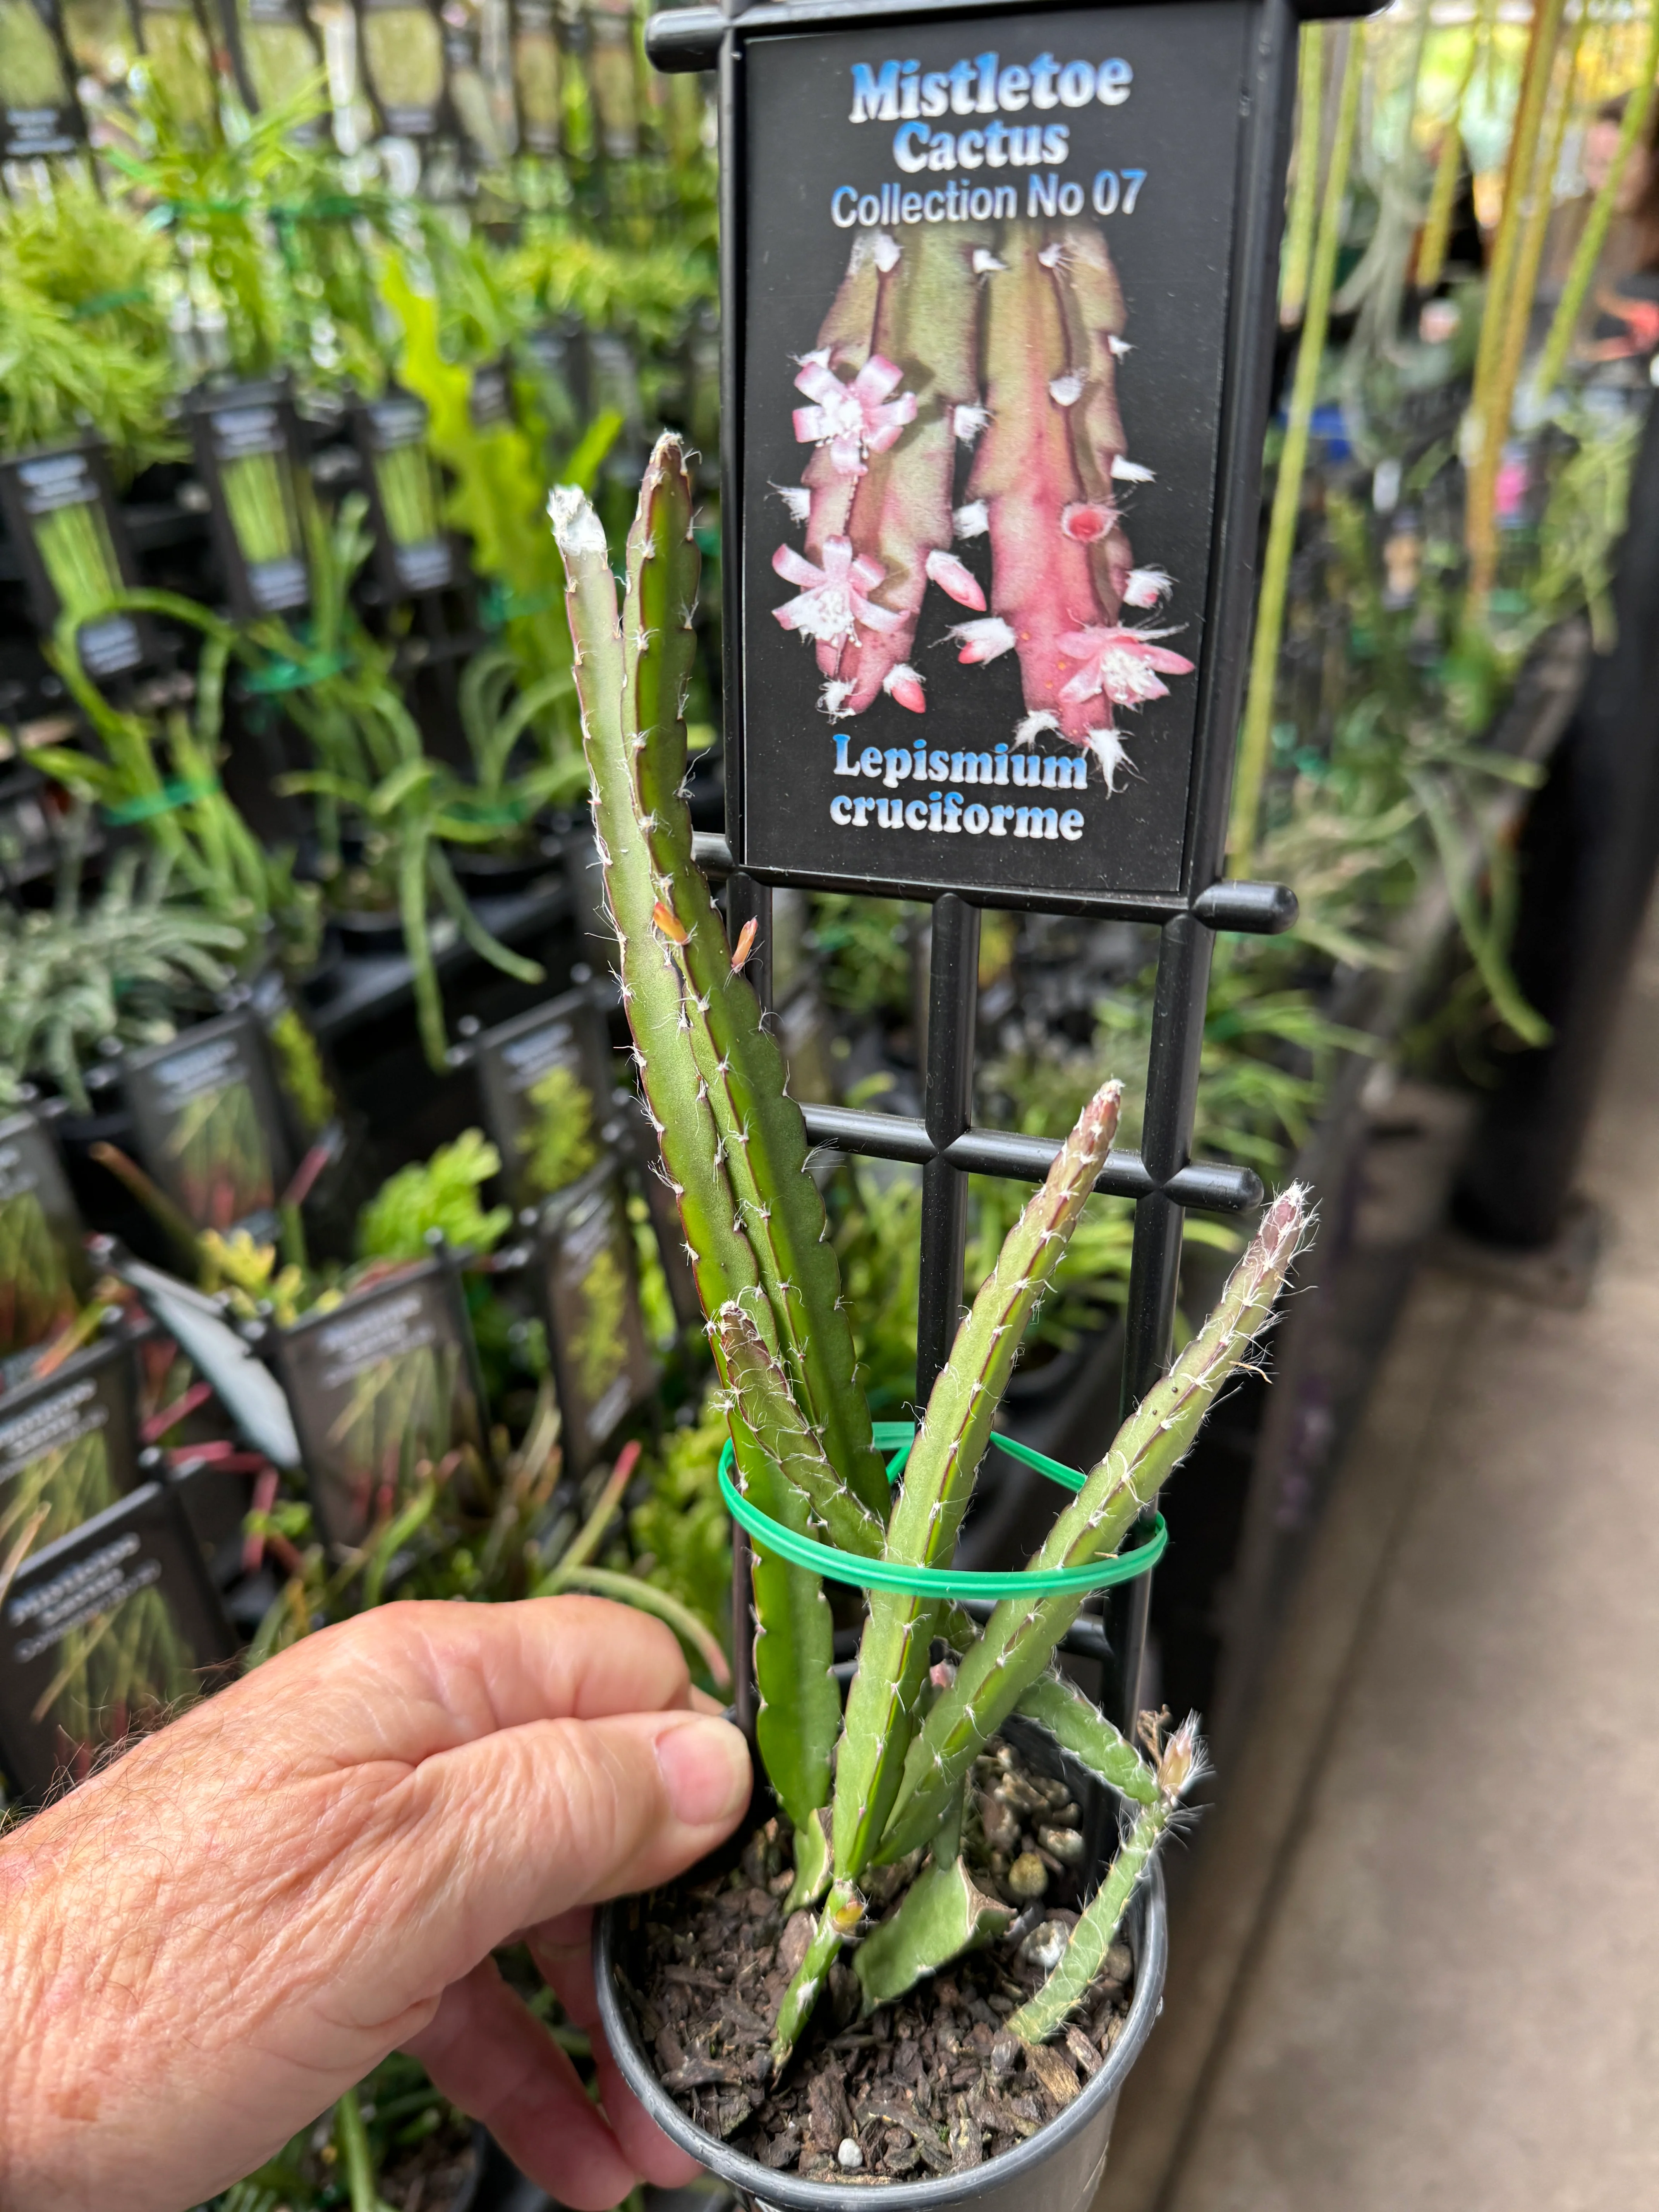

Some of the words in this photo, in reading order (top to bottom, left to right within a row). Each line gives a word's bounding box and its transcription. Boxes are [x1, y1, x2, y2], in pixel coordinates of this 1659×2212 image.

[849, 51, 1133, 123] Mistletoe
[893, 120, 1070, 173] Cactus
[831, 178, 1017, 228] Collection
[1027, 173, 1084, 217] No
[1092, 168, 1147, 216] 07
[832, 734, 1088, 788] Lepismium
[830, 791, 1084, 840] cruciforme
